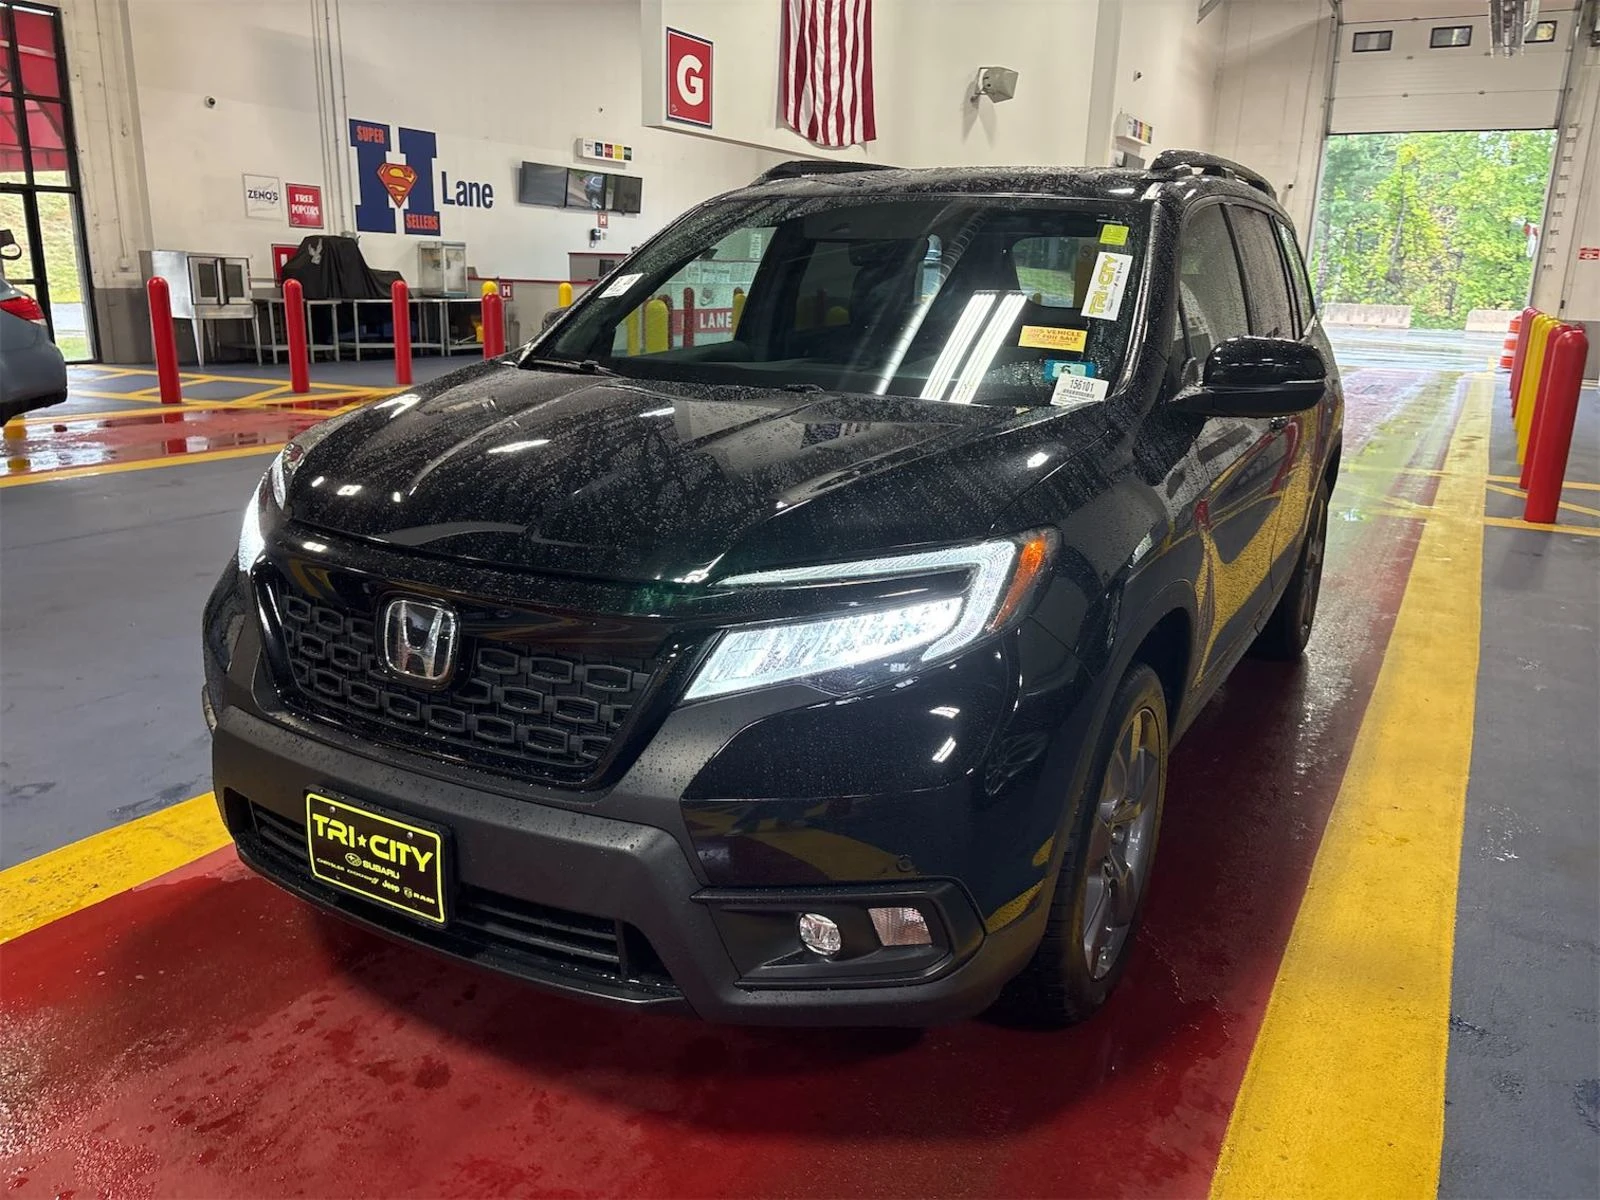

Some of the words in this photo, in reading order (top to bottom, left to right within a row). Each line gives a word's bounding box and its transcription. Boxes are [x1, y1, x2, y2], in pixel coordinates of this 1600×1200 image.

[677, 54, 704, 106] G
[356, 125, 385, 144] SUPER
[247, 189, 279, 201] ZENO'S
[294, 193, 314, 203] FREE
[441, 171, 494, 209] Lane
[291, 204, 319, 216] POPCORN
[600, 213, 607, 225] H
[406, 214, 439, 230] SELLERS
[1098, 254, 1118, 286] CITY
[502, 285, 511, 296] H
[1088, 291, 1110, 315] TRI
[700, 311, 733, 329] LANE
[1046, 328, 1083, 338] VEHICLE
[312, 813, 356, 848] TRI
[369, 834, 434, 873] CITY
[362, 860, 400, 879] SUBARU
[381, 880, 400, 893] Jeep
[413, 892, 436, 904] RAM
